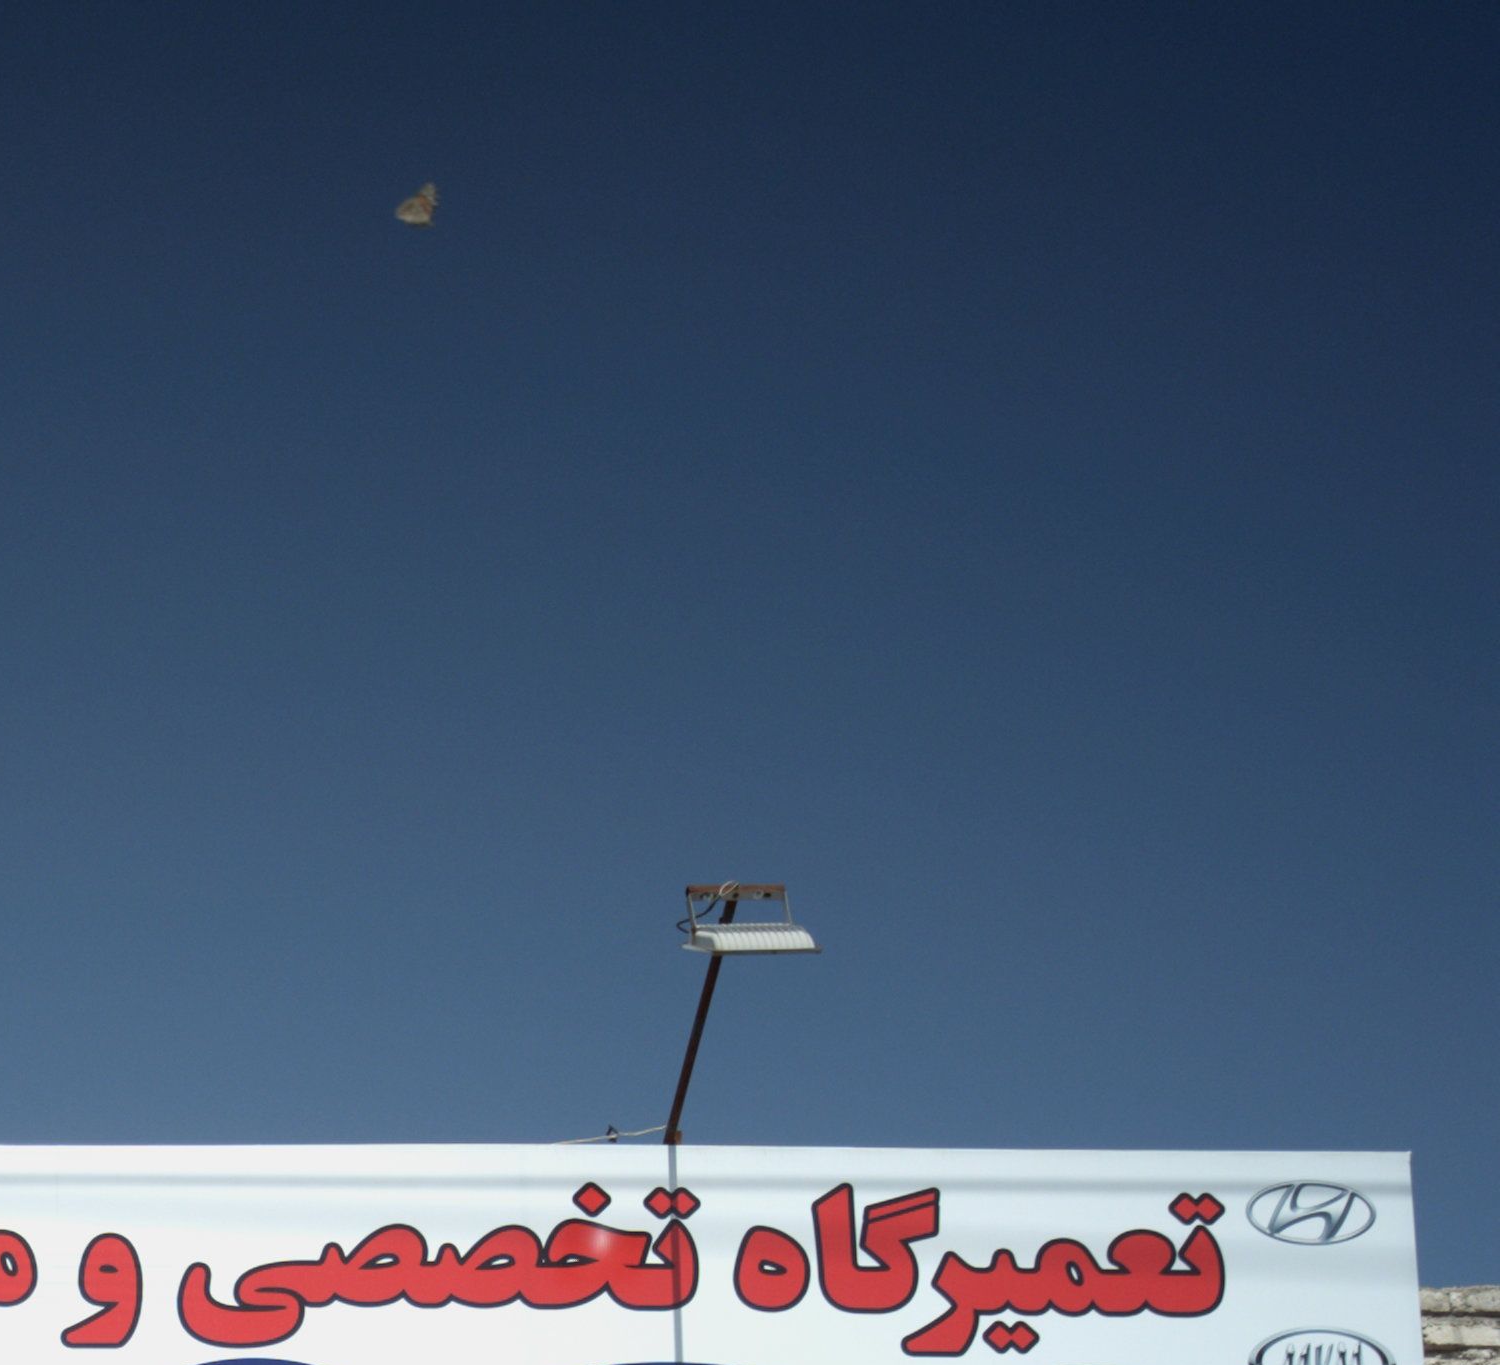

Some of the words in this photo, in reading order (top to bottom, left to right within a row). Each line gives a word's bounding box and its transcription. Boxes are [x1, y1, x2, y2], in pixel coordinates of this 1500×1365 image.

[61, 1232, 142, 1348] و
[179, 1182, 699, 1348] تخصصی
[735, 1182, 1225, 1356] تعمیرگاه
